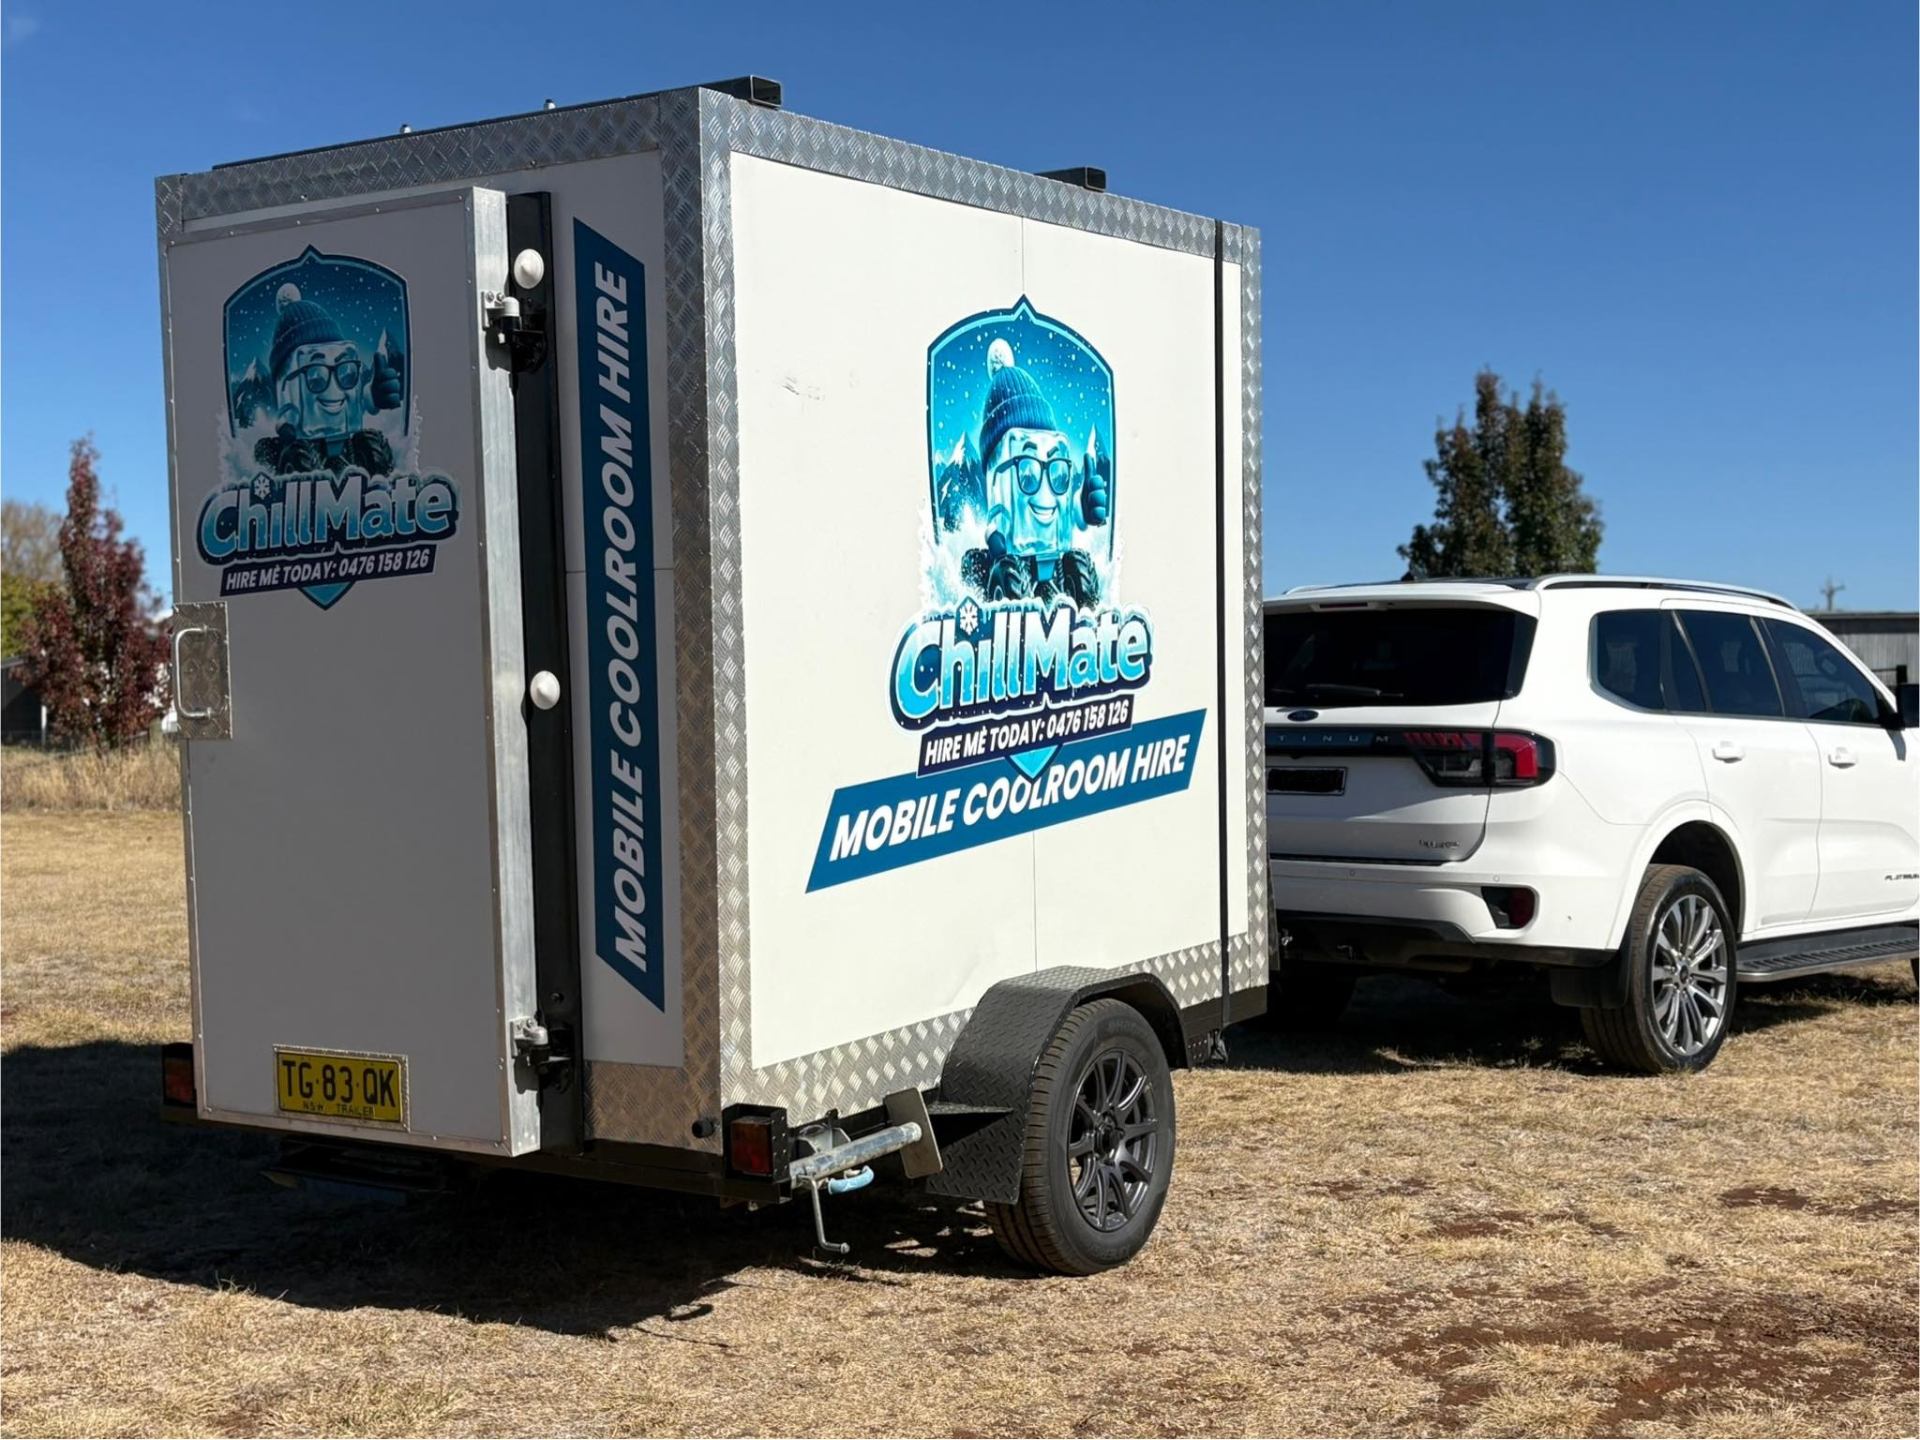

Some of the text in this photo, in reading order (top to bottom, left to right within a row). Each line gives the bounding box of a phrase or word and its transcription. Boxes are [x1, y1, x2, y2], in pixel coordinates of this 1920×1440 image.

[202, 475, 452, 557] ChillMate
[225, 570, 256, 591] HIRE
[283, 561, 336, 584] TODAY:
[338, 555, 375, 577] 0476
[377, 551, 404, 573] 158
[406, 548, 430, 570] 126
[594, 260, 647, 973] MOBILE COOLROOM HIRE
[895, 607, 1148, 719] ChillMate
[924, 735, 962, 766] HIRE
[990, 717, 1046, 754] TODAY:
[1046, 708, 1079, 739] 0476
[1082, 703, 1105, 733] 158
[1107, 699, 1130, 727] 126
[829, 733, 1191, 862] MOBILE COOLROOM HIRE
